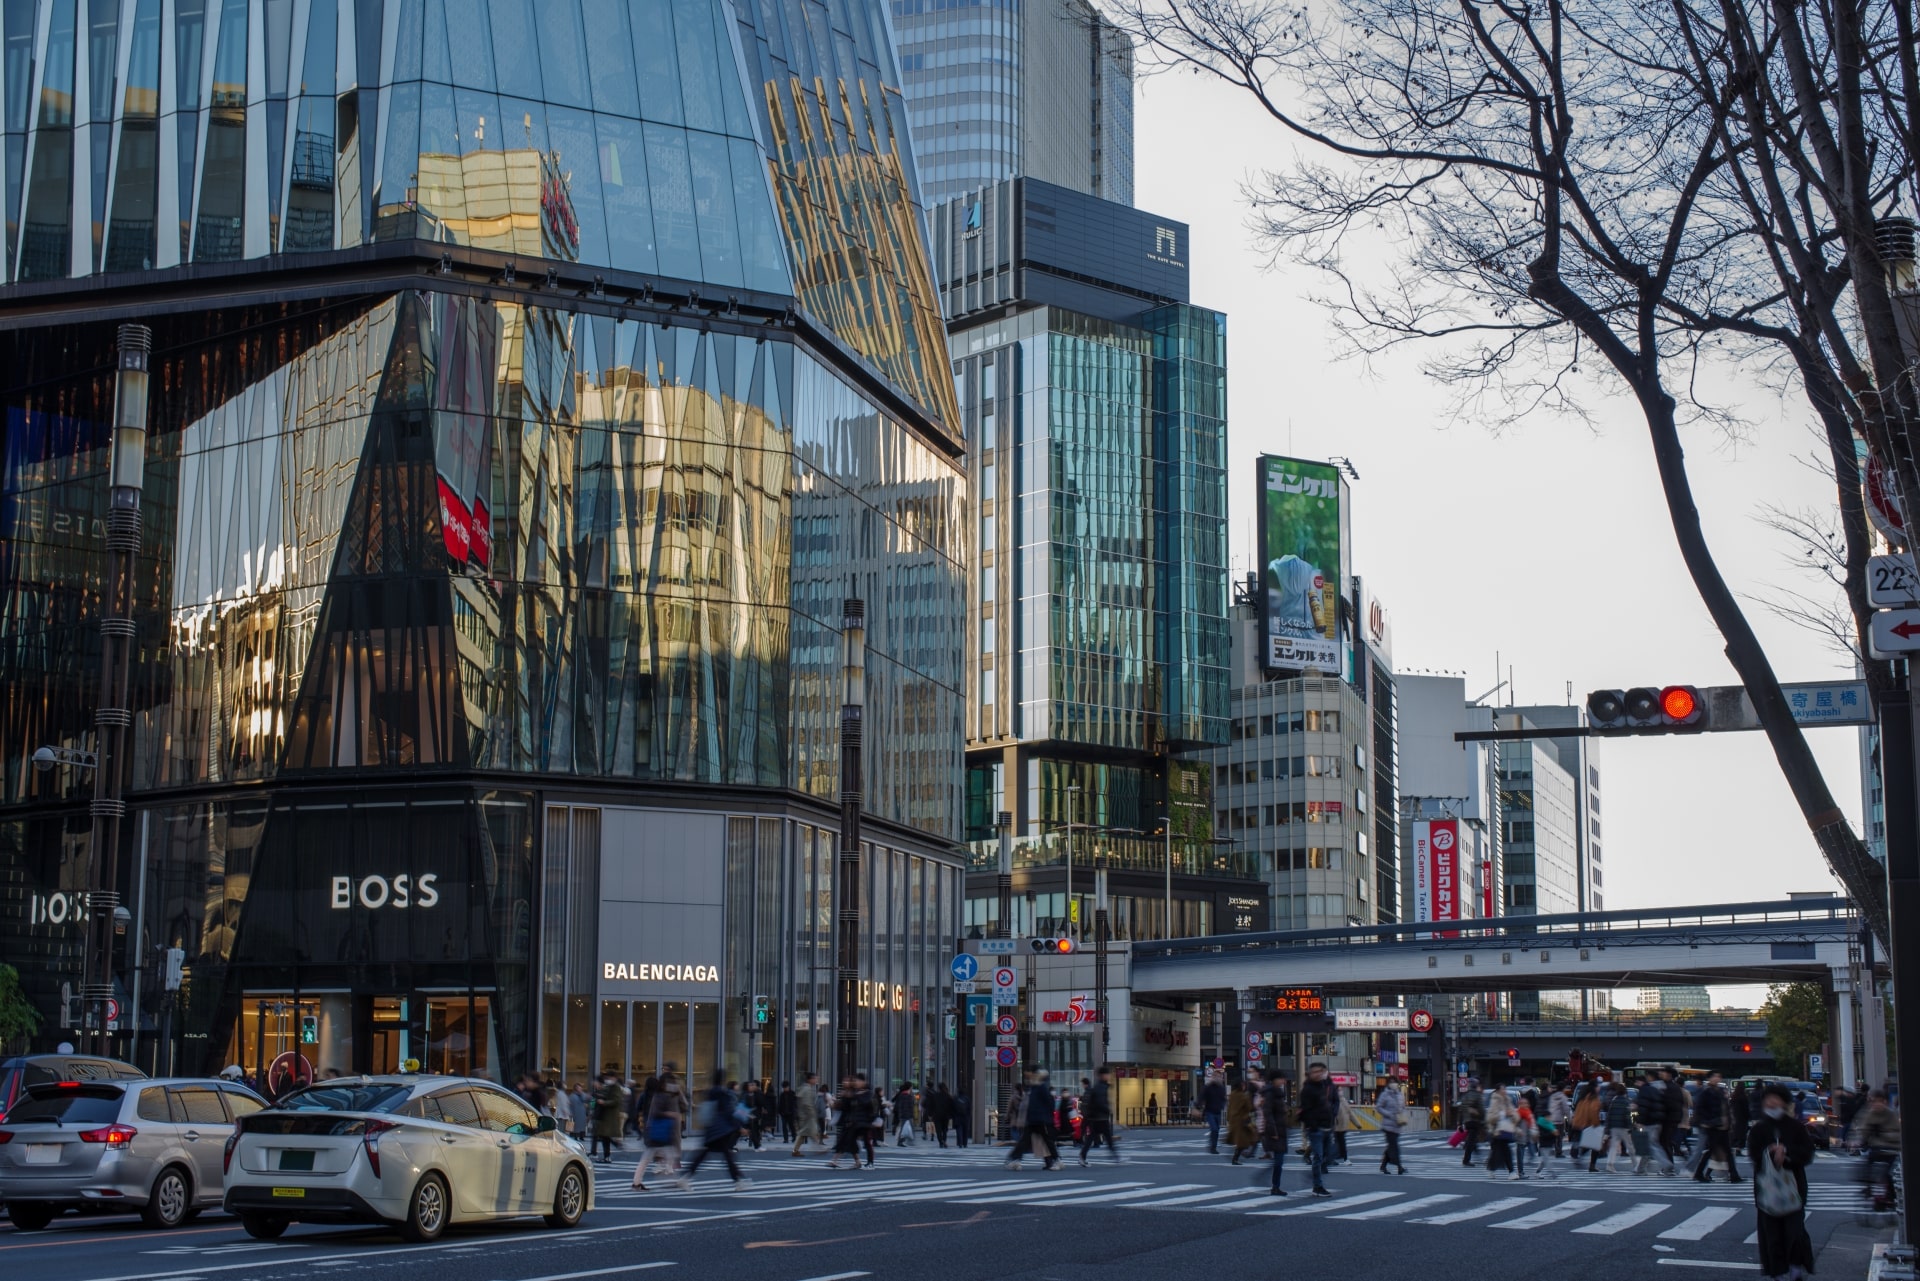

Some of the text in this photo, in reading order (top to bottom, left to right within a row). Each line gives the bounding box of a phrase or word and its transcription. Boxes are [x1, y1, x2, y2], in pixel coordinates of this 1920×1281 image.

[1267, 471, 1338, 499] ユンケル
[1274, 647, 1316, 662] ユンケル
[1792, 690, 1857, 708] 寄屋橋
[1792, 707, 1841, 719] ukiyabashi
[1418, 840, 1426, 888] BicCamera
[331, 873, 439, 908] BOSS
[604, 963, 719, 982] BALENCIAGA
[1811, 1056, 1820, 1066] P
